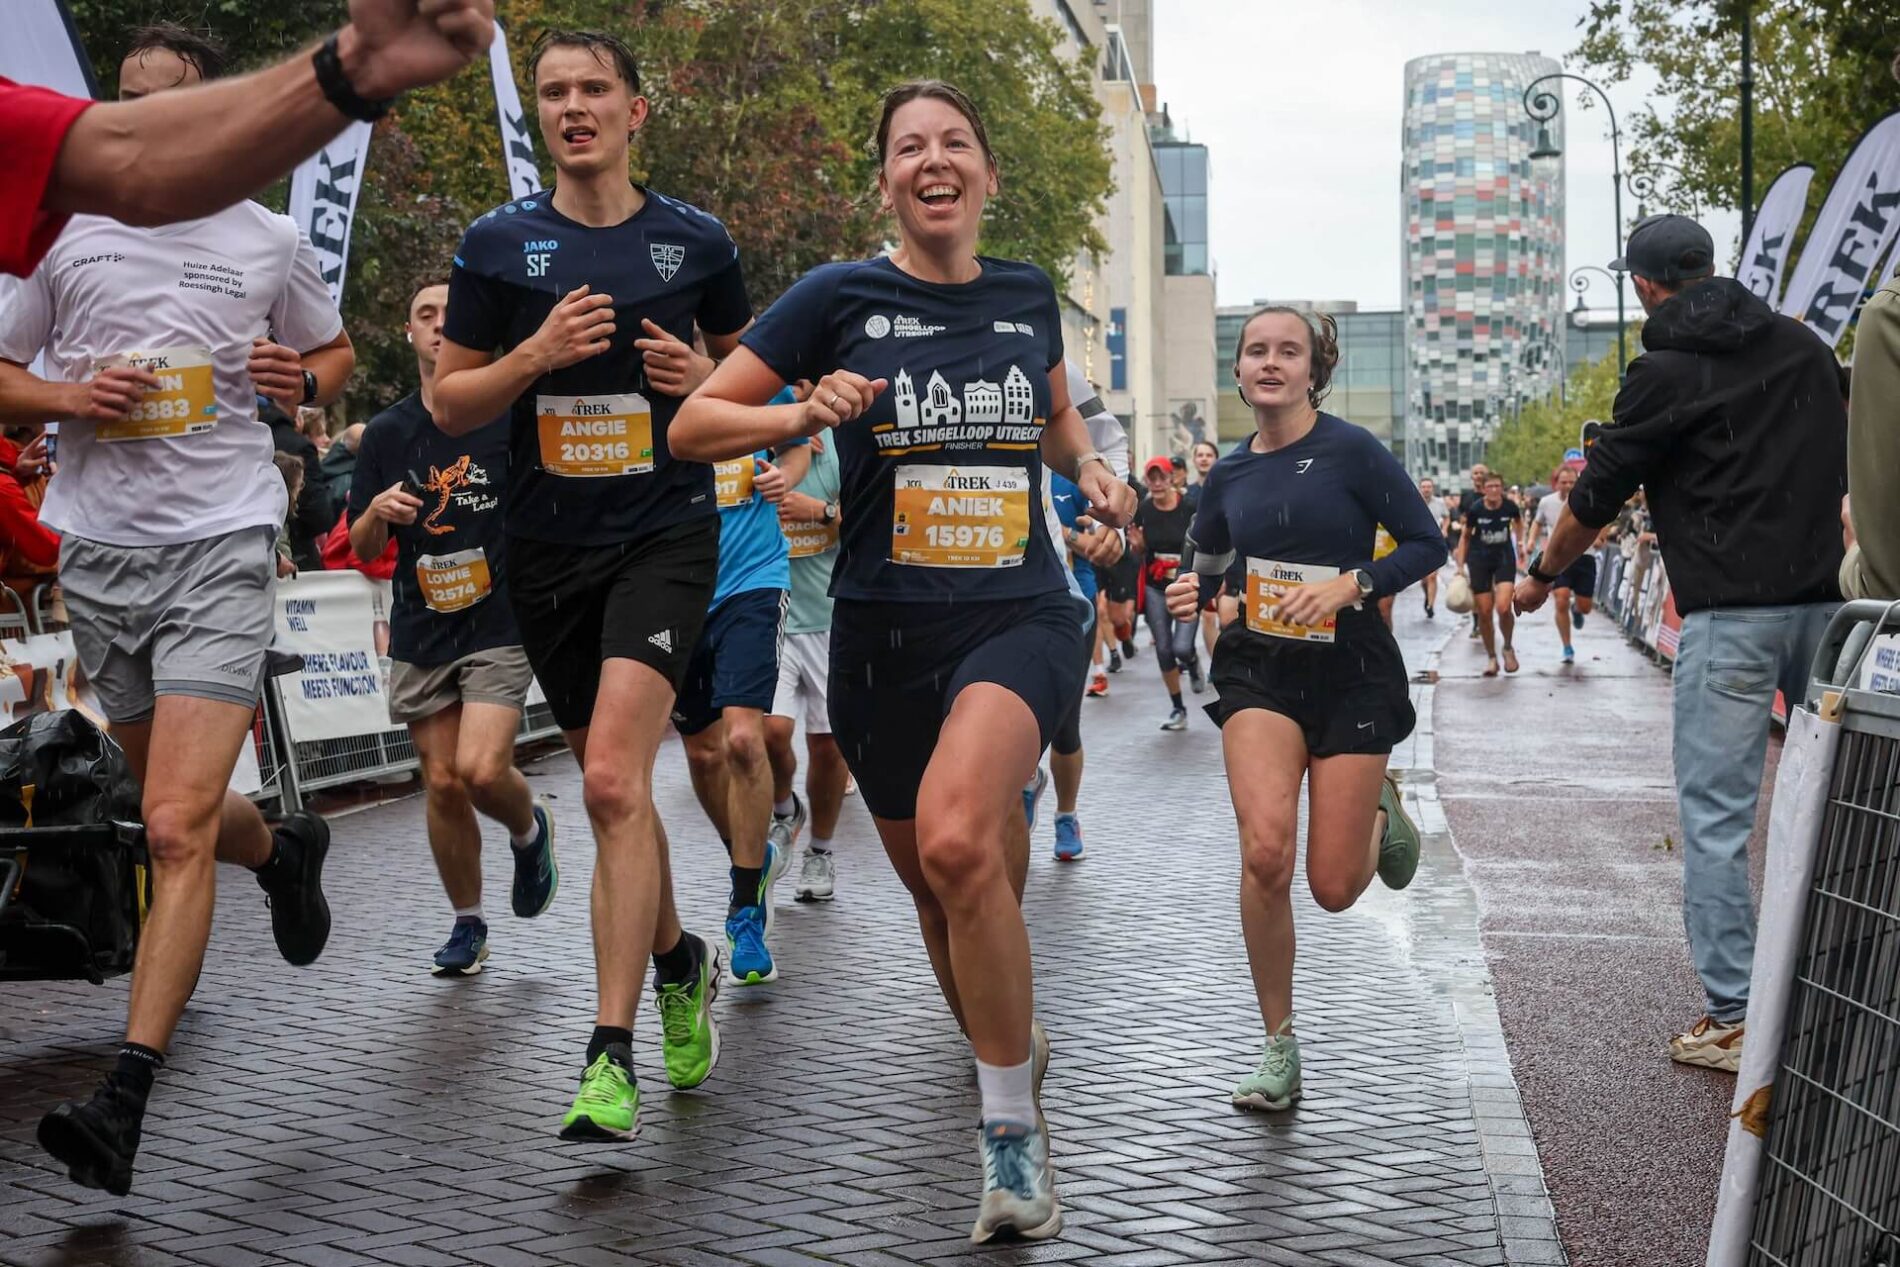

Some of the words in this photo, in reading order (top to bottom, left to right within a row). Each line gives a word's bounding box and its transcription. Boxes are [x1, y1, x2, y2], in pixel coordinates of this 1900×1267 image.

[523, 240, 558, 252] JAKO
[72, 255, 112, 268] CRAFT
[183, 261, 208, 270] Huize
[209, 264, 244, 277] Adelaar
[526, 254, 551, 277] SF
[184, 271, 230, 284] sponsored
[231, 276, 243, 288] by
[179, 280, 223, 293] Roessingh
[224, 286, 247, 299] Legal
[576, 403, 612, 415] TREK
[561, 419, 627, 436] ANGIE
[874, 430, 911, 448] TREK
[913, 425, 994, 444] SINGELLOOP
[995, 426, 1044, 441] UTRECHT
[561, 441, 630, 461] 20316
[944, 442, 983, 450] FINISHER
[947, 476, 991, 490] TREK
[1002, 480, 1017, 489] 439
[455, 495, 480, 506] Take
[473, 496, 498, 512] Leap!
[927, 496, 1005, 517] ANIEK
[925, 525, 1005, 548] 15976
[432, 559, 457, 570] TREK
[426, 566, 472, 585] LOWIE
[1272, 568, 1304, 582] TREK
[285, 599, 316, 615] VITAMIN
[287, 616, 309, 632] WELL
[331, 651, 370, 672] FLAVOUR
[301, 679, 332, 699] MEETS
